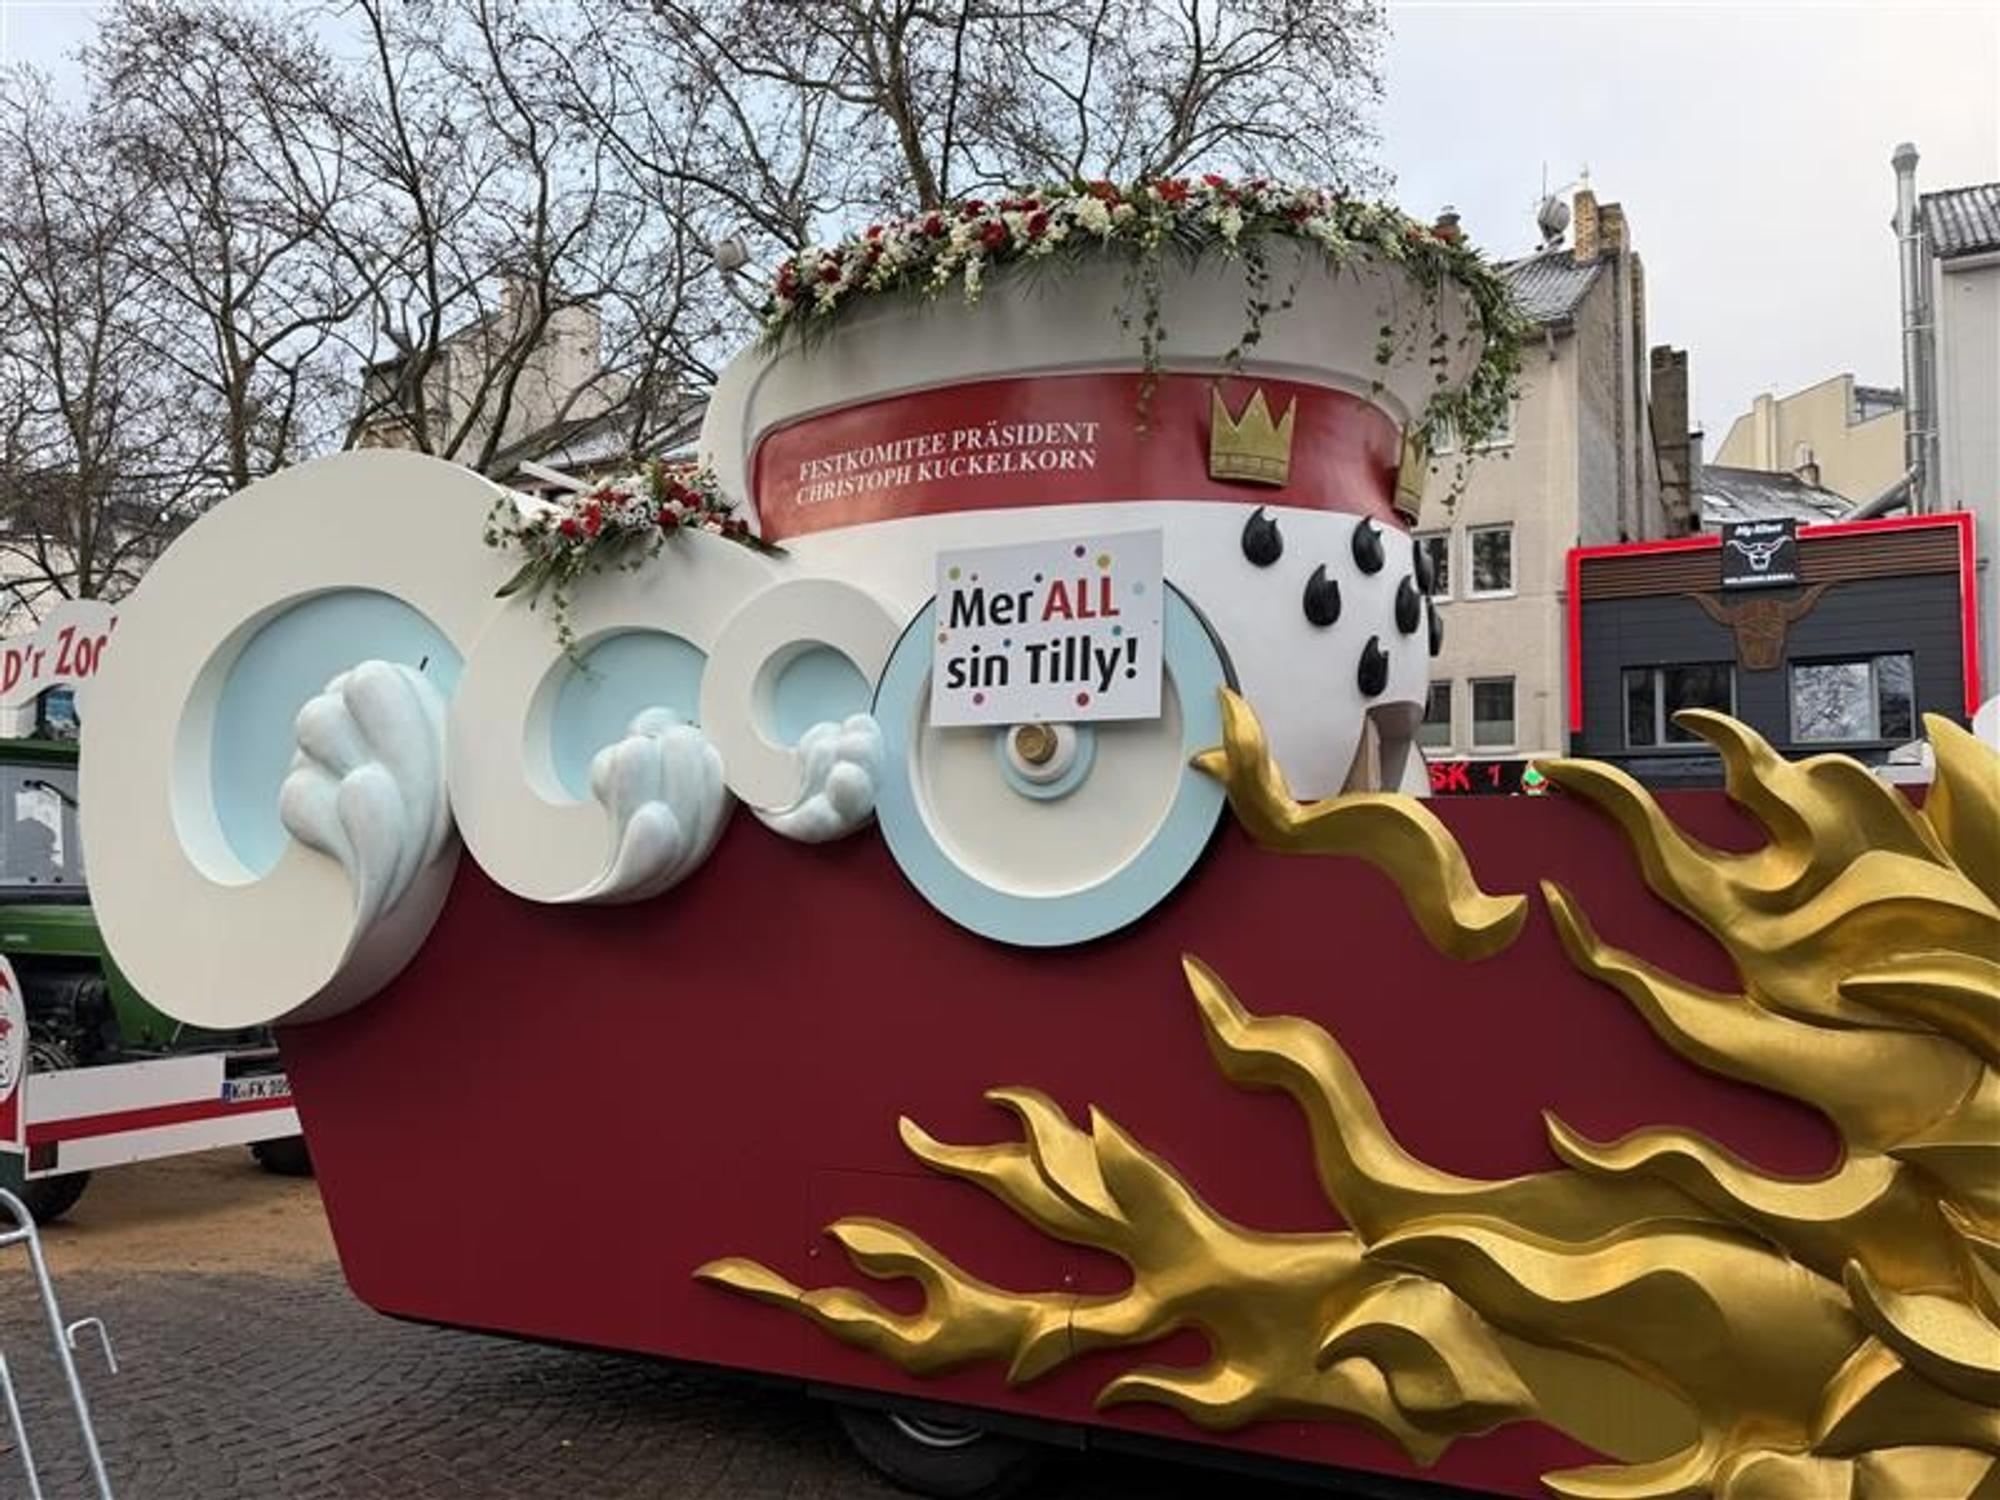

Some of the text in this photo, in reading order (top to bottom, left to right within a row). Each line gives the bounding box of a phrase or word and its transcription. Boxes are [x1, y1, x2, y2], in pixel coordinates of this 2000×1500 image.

[796, 449, 1098, 505] CHRISTOPH KUCKELKORN
[799, 420, 1100, 482] FESTKOMITEE PRÄSIDENT
[949, 575, 1121, 629] Mer ALL
[946, 634, 1139, 693] sin Tilly!
